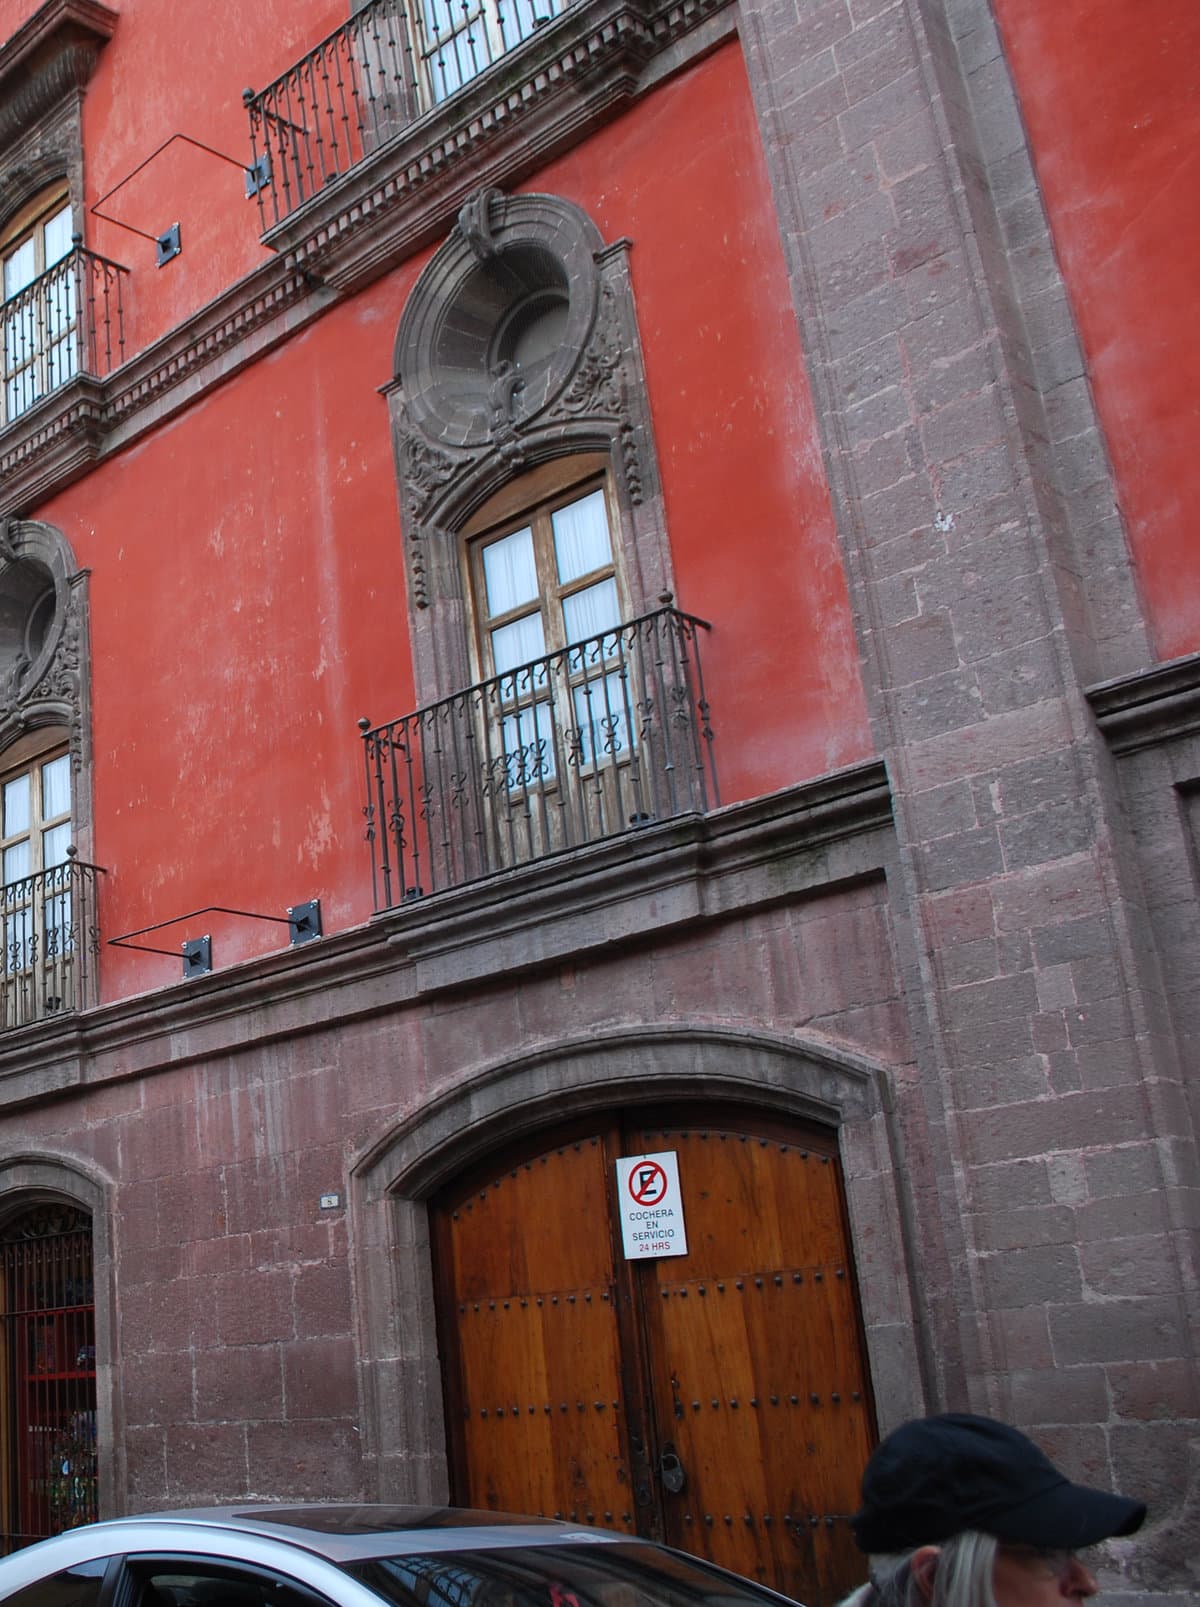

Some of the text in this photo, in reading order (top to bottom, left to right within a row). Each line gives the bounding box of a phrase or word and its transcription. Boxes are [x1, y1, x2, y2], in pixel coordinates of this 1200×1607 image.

[629, 1209, 674, 1221] COCHERA
[646, 1221, 659, 1230] EN
[632, 1229, 675, 1241] SERVICIO
[639, 1241, 671, 1252] 24 HRS
